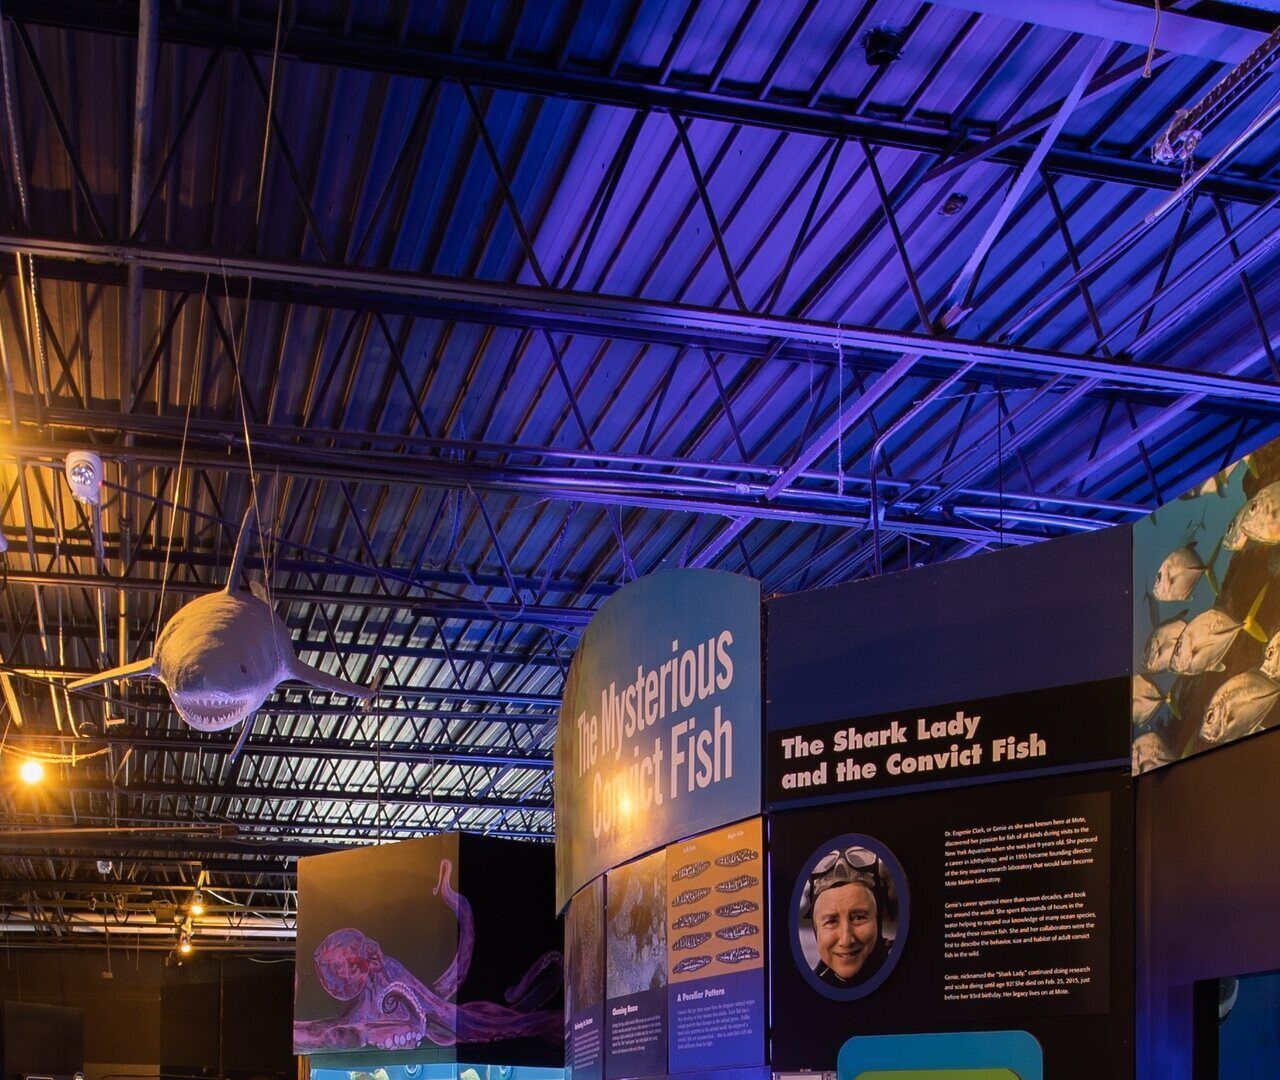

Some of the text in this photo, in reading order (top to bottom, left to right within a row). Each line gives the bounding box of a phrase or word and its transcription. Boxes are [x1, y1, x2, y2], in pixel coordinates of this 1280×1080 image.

[577, 629, 733, 778] The Mysterious
[670, 706, 732, 799] Fish
[781, 711, 981, 759] The Shark Lady
[781, 733, 1046, 789] and the Convict Fish
[682, 989, 703, 1002] Peculiar
[704, 987, 725, 998] Pattern
